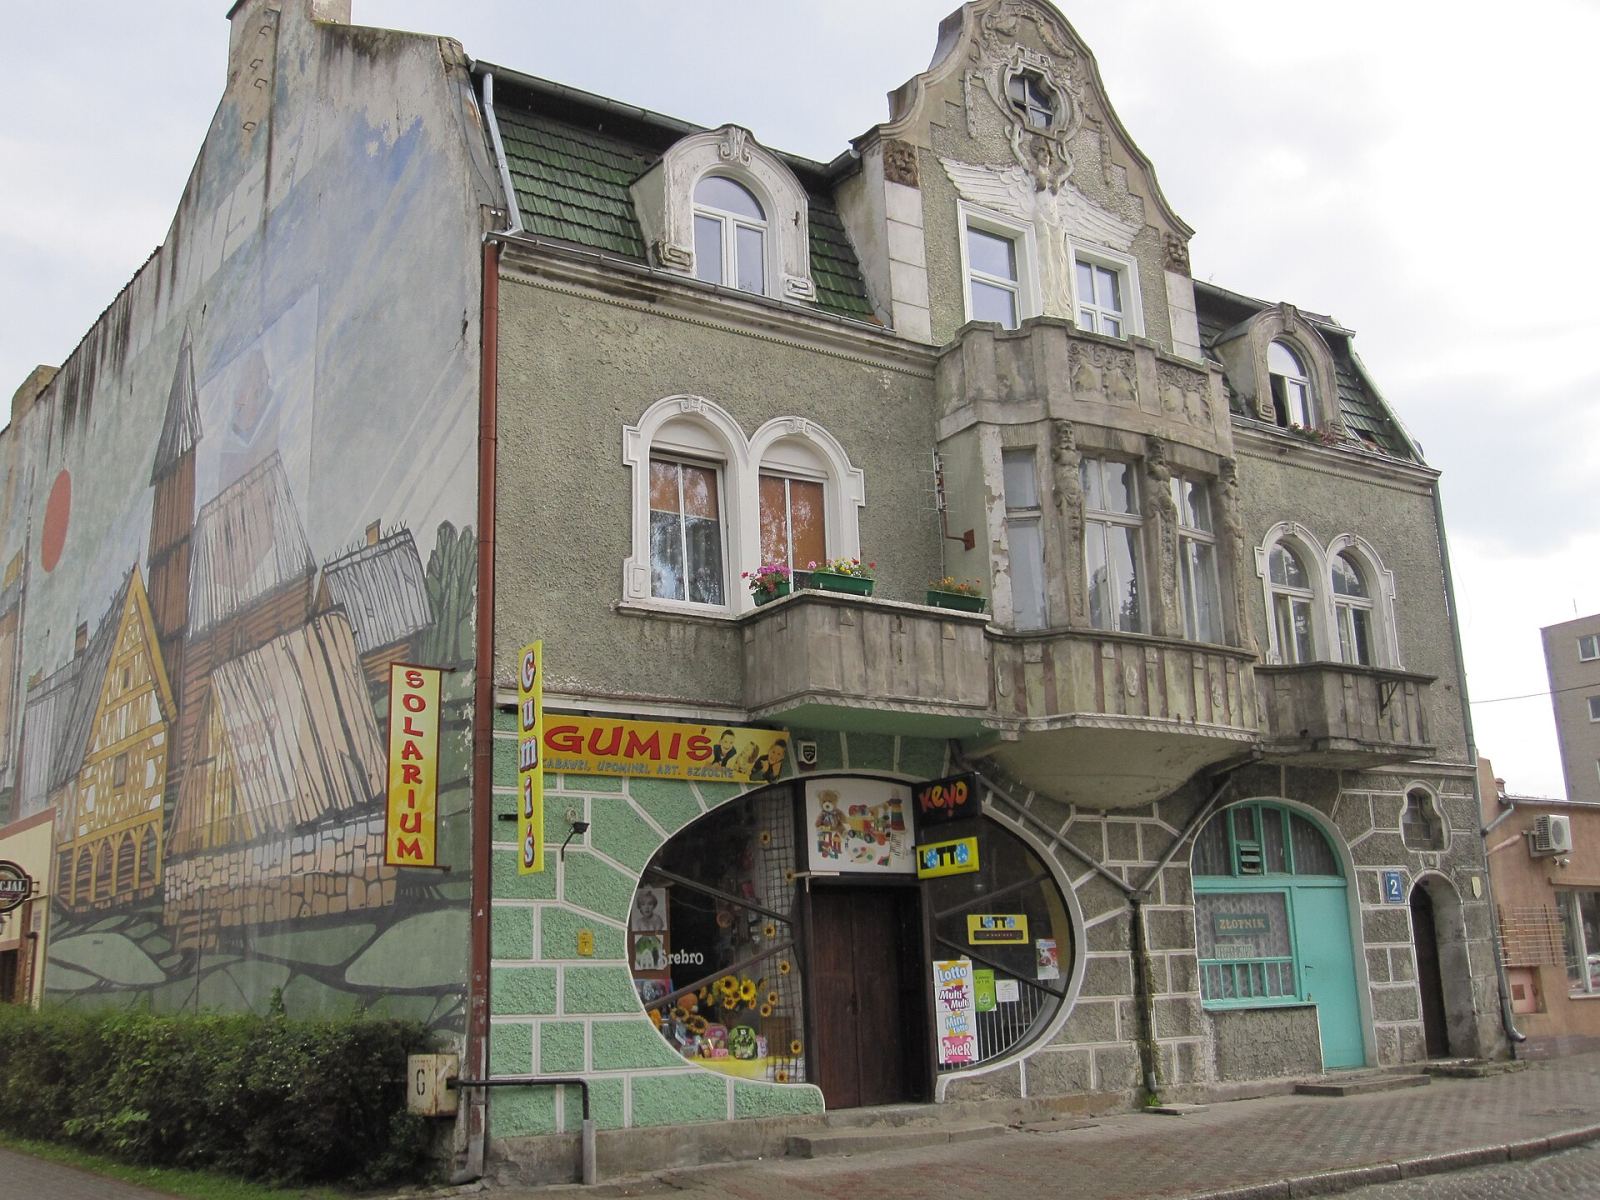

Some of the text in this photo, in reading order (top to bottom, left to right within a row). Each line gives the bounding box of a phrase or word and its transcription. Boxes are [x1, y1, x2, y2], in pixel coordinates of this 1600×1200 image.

[543, 725, 713, 761] GUMIŚ
[396, 670, 426, 860] SOLARIUM
[919, 843, 969, 871] LOTTO
[1390, 879, 1399, 895] 2
[980, 915, 1015, 929] LOTTO
[938, 966, 968, 982] Lotto
[939, 988, 963, 1001] Multi
[951, 998, 971, 1011] Multi
[945, 1011, 966, 1030] Mini
